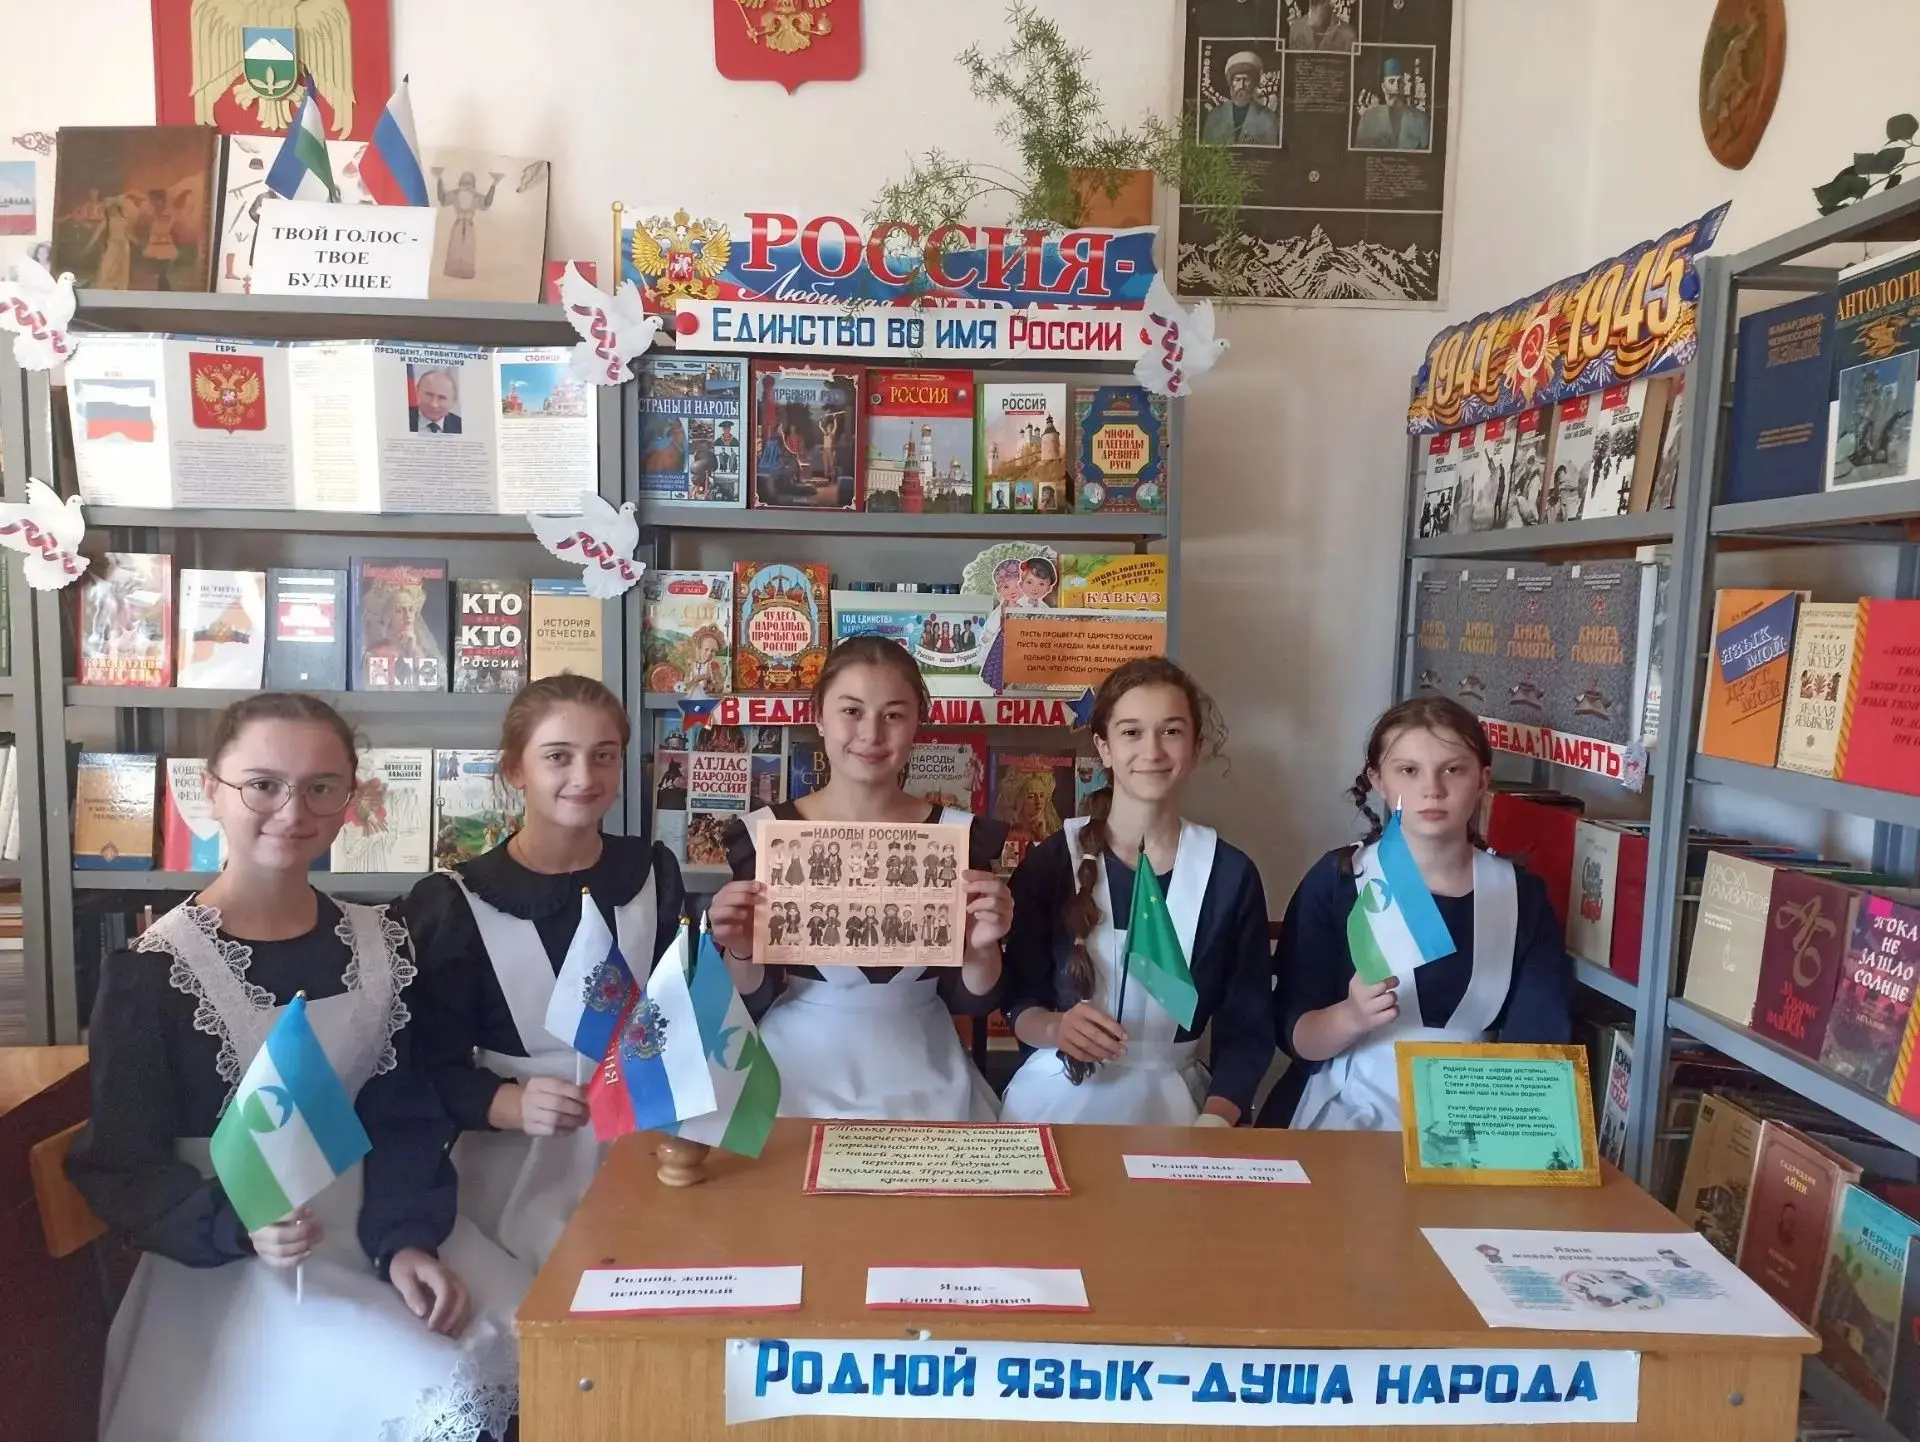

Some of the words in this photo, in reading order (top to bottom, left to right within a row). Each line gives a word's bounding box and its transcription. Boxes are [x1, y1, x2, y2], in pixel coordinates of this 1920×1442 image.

[272, 227, 330, 243] ТВОЙ
[335, 229, 405, 246] ГОЛОС
[315, 251, 370, 265] ТВОЕ
[288, 272, 392, 289] БУДУЩЕЕ
[1566, 231, 1696, 363] 1945
[1836, 270, 1920, 322] АНТОЛОГИ
[713, 308, 875, 347] ЕДИНСТВО
[888, 318, 924, 348] ВО
[936, 319, 997, 349] ИМЯ
[1009, 315, 1122, 351] РОССИИ
[216, 344, 237, 353] ГЕРБ
[374, 347, 423, 357] ПРЕЗИДЕНТ,
[424, 350, 489, 360] ПРАВИТЕЛЬСТВО
[408, 357, 465, 366] КОНСТИТУЦИЯ
[1427, 321, 1500, 409] 1941
[889, 386, 949, 404] РОССИЯ
[639, 399, 682, 415] СТРАНЫ
[684, 400, 691, 415] И
[695, 401, 740, 417] НАРОДЫ
[1002, 398, 1047, 410] РОССИЯ
[1104, 429, 1135, 439] МИФЫ
[1104, 440, 1144, 450] ЛЕГЕНДЫ
[1109, 460, 1131, 470] РУСИ
[462, 593, 522, 615] КТО
[1086, 592, 1160, 603] КАВКАЗ
[543, 619, 590, 627] ИСТОРИЯ
[763, 611, 797, 622] ЧУДЕСА
[842, 614, 856, 624] ГОД
[858, 615, 893, 623] ЕДИНСТВА
[754, 621, 805, 632] НАРОДНЫХ
[461, 625, 521, 648] КТО
[537, 629, 596, 638] ОТЕЧЕСТВА
[752, 631, 809, 642] ПРОМЫСЛОВ
[1579, 626, 1619, 645] КНИГА
[763, 641, 798, 652] РОССИИ
[1721, 626, 1772, 665] ЯЗЫК
[721, 697, 740, 724] В
[751, 699, 815, 724] ЕДИ
[929, 699, 985, 724] АША
[996, 700, 1066, 726] СИЛА
[1540, 727, 1621, 777] ПАМЯТЬ
[694, 757, 748, 771] АТЛАС
[912, 755, 955, 764] НАРОДЫ
[912, 764, 955, 772] РОССИИ
[692, 771, 747, 783] НАРОДОВ
[692, 782, 747, 793] РОССИИ
[813, 828, 864, 840] НАРОДЫ
[869, 829, 918, 841] РОССИИ
[1881, 936, 1901, 956] НЕ
[1858, 947, 1914, 981] ЗАШЛО
[1854, 968, 1910, 1003] СОЛНЦЕ
[889, 1126, 934, 1134] родной
[838, 1134, 919, 1142] человеческие
[755, 1339, 978, 1397] РОДНОЙ
[1375, 1360, 1598, 1405] НАРОДА
